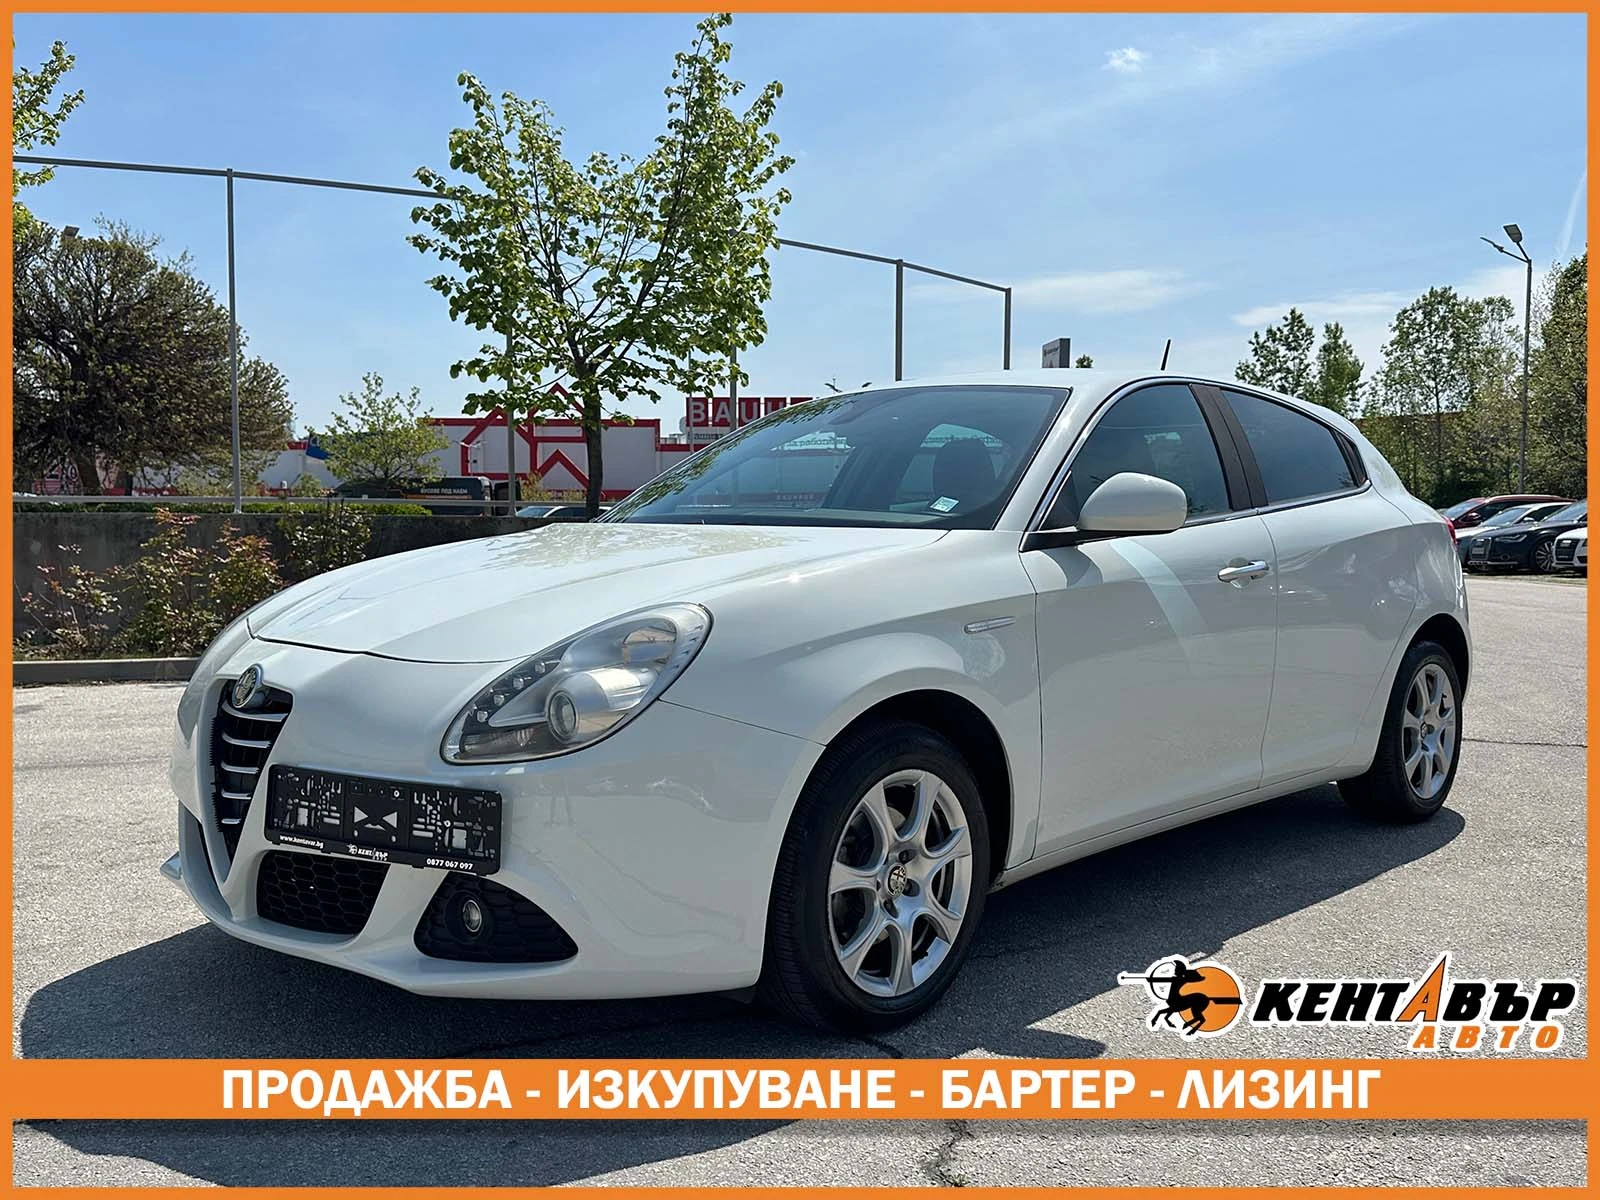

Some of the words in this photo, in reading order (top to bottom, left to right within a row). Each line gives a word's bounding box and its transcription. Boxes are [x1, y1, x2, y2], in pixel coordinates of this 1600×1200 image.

[426, 858, 445, 867] 0877
[444, 860, 459, 868] 067
[459, 862, 474, 870] 097
